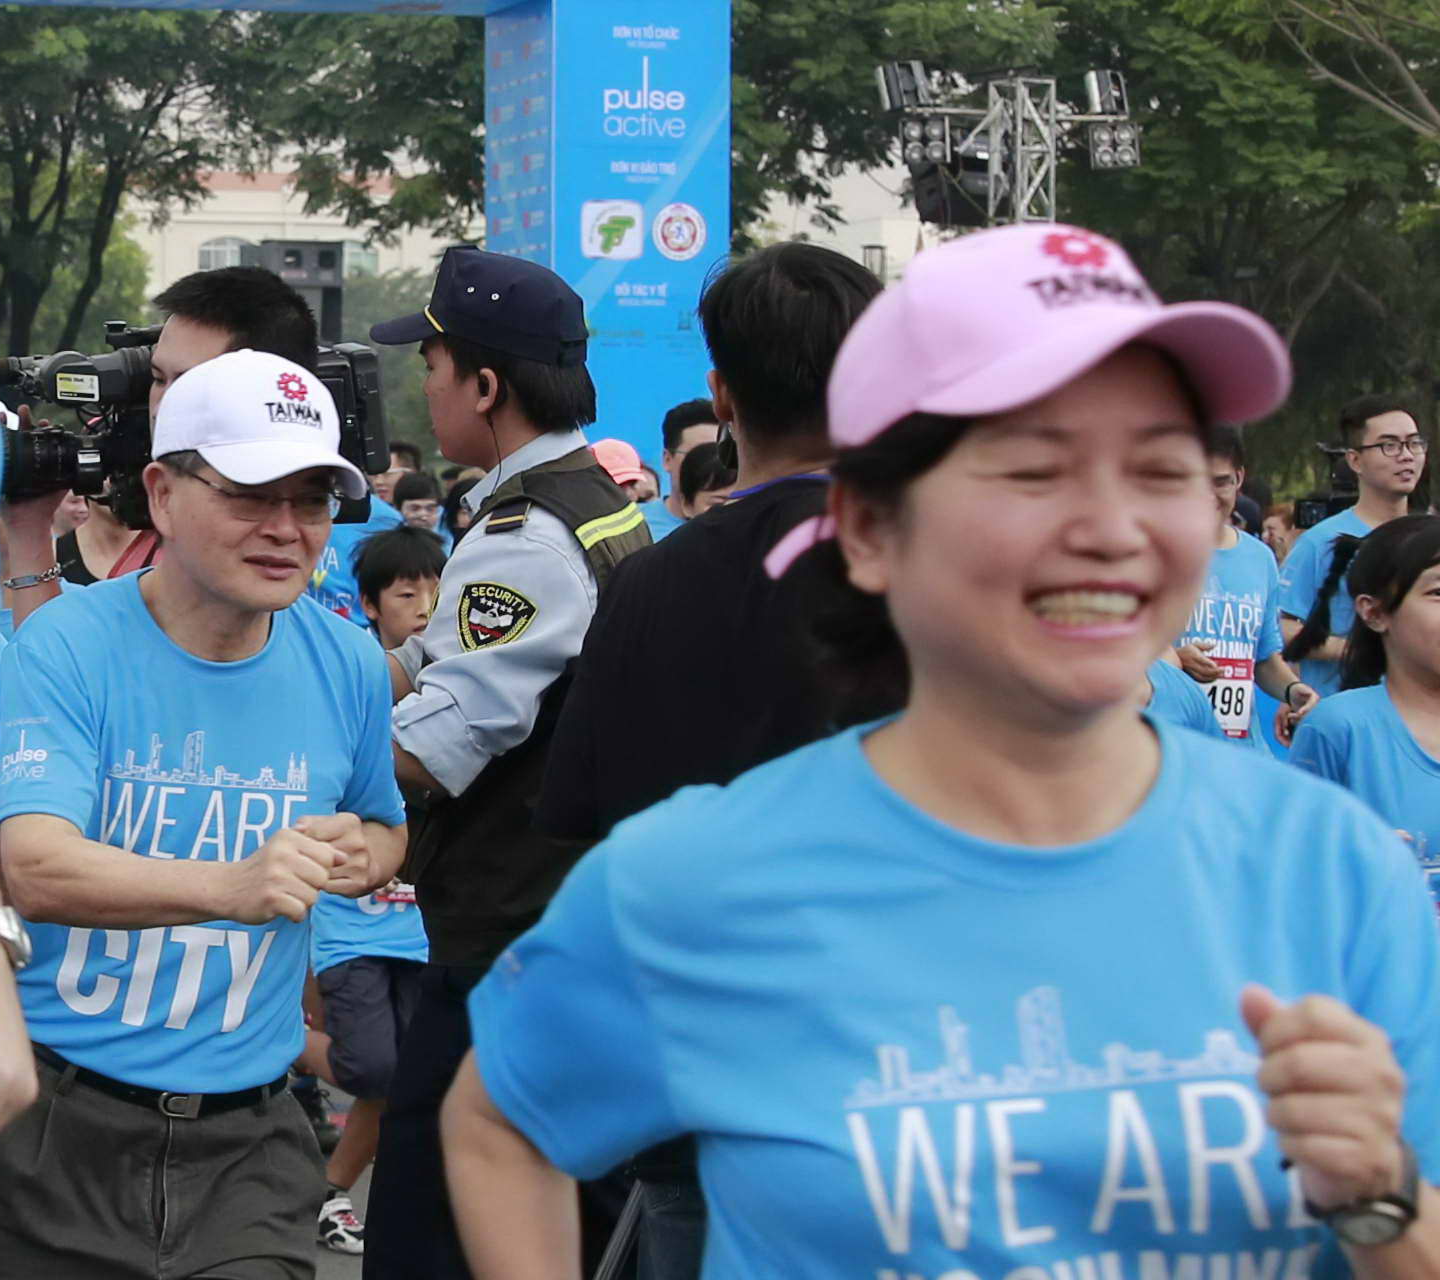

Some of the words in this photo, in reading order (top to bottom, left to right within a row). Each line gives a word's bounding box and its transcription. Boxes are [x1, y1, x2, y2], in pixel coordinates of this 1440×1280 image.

[603, 56, 685, 113] pulse
[603, 113, 685, 138] active
[264, 402, 321, 422] TAIWAN
[471, 586, 528, 611] SECURITY
[1221, 602, 1263, 640] ARE
[100, 778, 186, 859] WE
[57, 926, 277, 1032] CITY
[847, 1099, 1057, 1255] WE
[1089, 1081, 1320, 1234] AR
